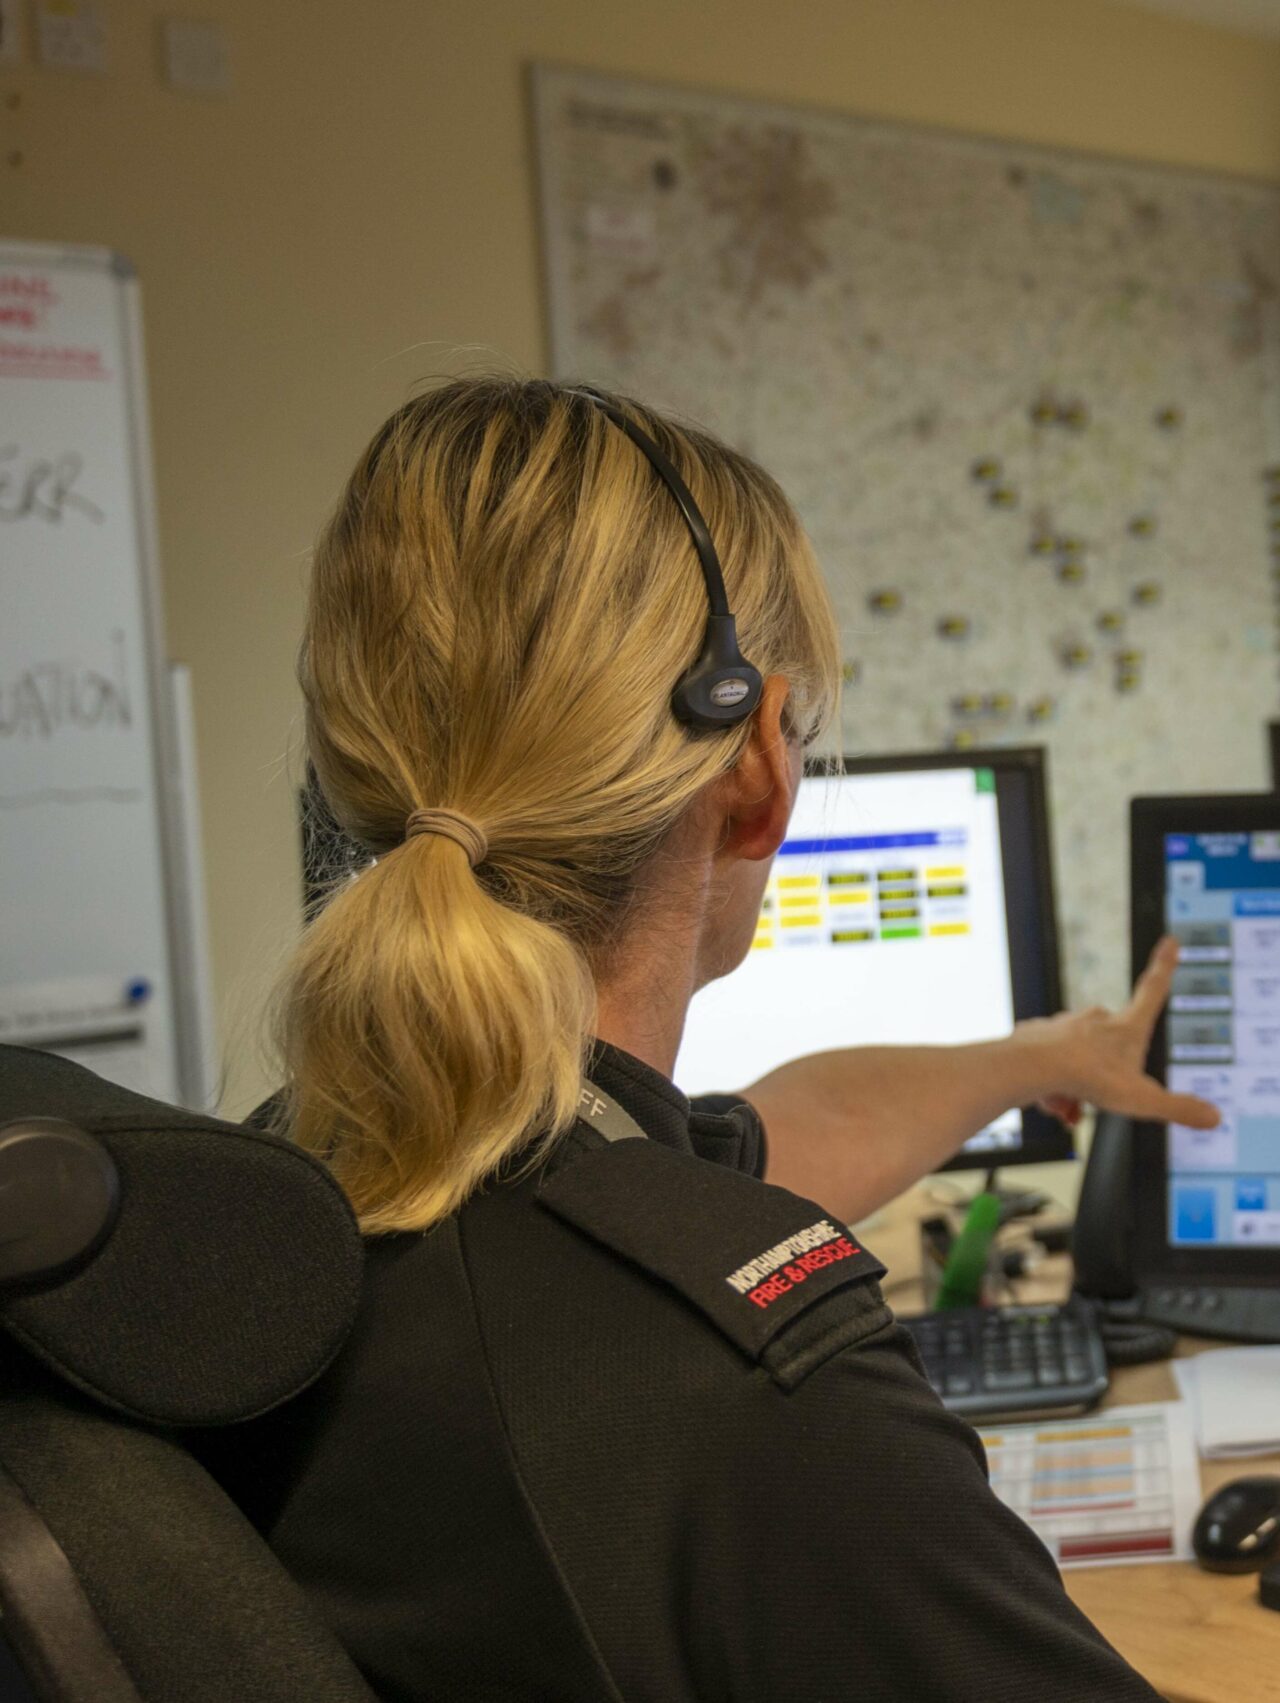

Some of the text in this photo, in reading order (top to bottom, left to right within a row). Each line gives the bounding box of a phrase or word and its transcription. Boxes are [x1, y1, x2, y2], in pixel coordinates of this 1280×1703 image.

[726, 1219, 842, 1294] NORTHAMPTONSHIRE
[748, 1237, 861, 1309] FIRE & RESCUE
